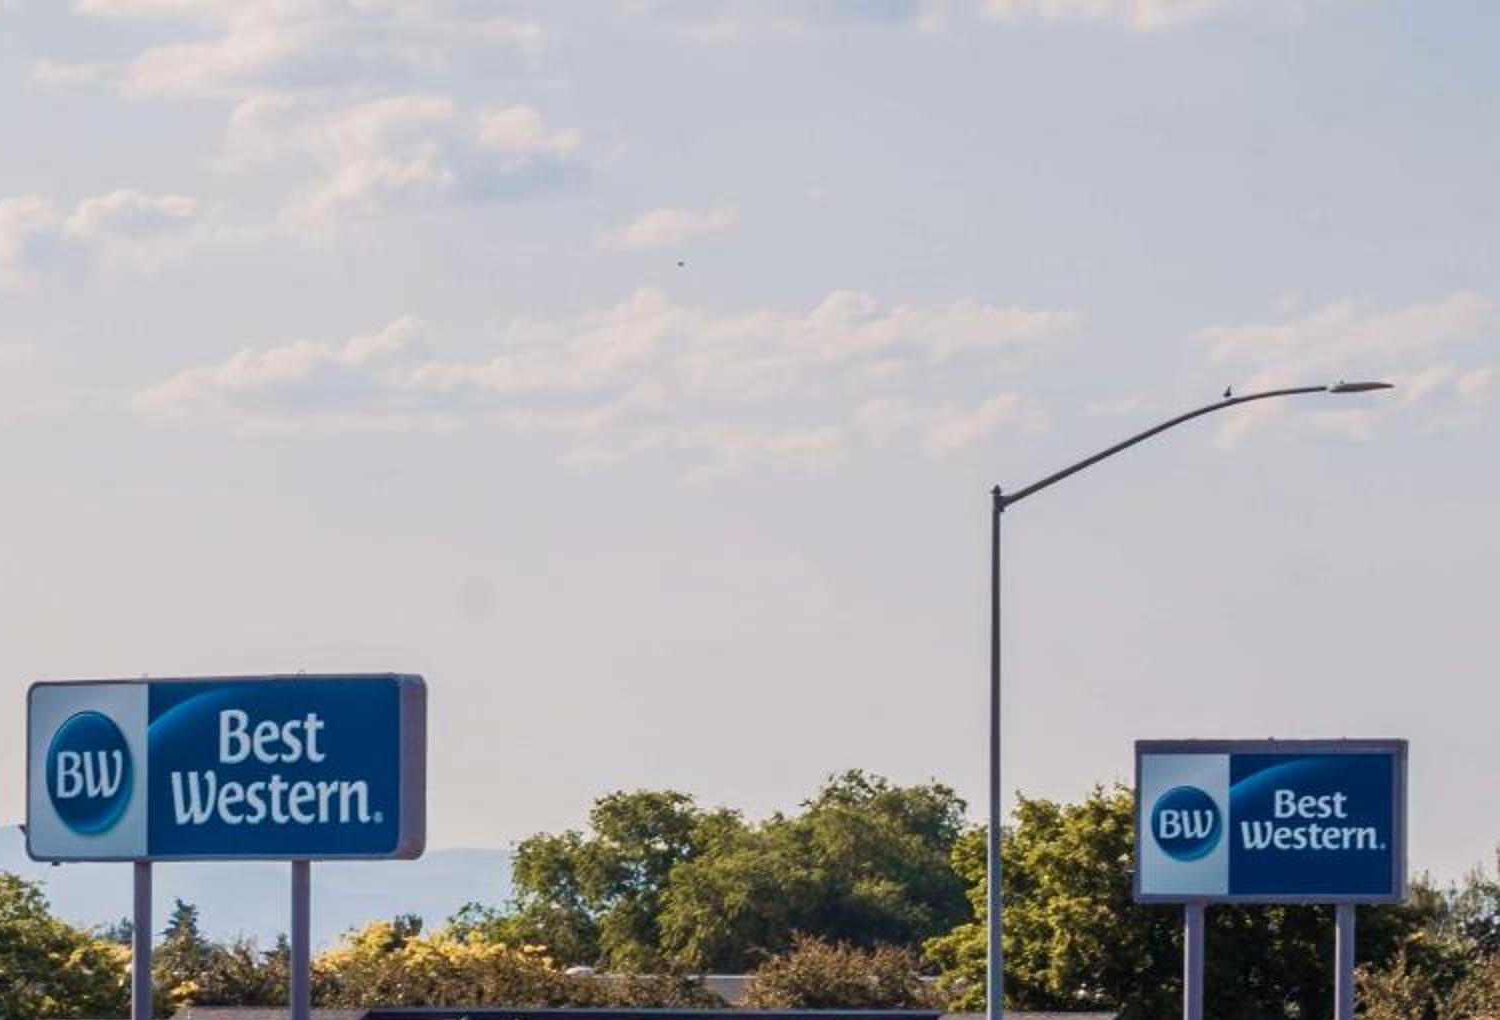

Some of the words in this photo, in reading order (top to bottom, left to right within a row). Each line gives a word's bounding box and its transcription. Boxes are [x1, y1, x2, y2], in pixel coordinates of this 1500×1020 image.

[219, 709, 325, 766] Best
[56, 749, 123, 799] BW
[1274, 789, 1348, 819] Best
[1158, 809, 1214, 840] BW
